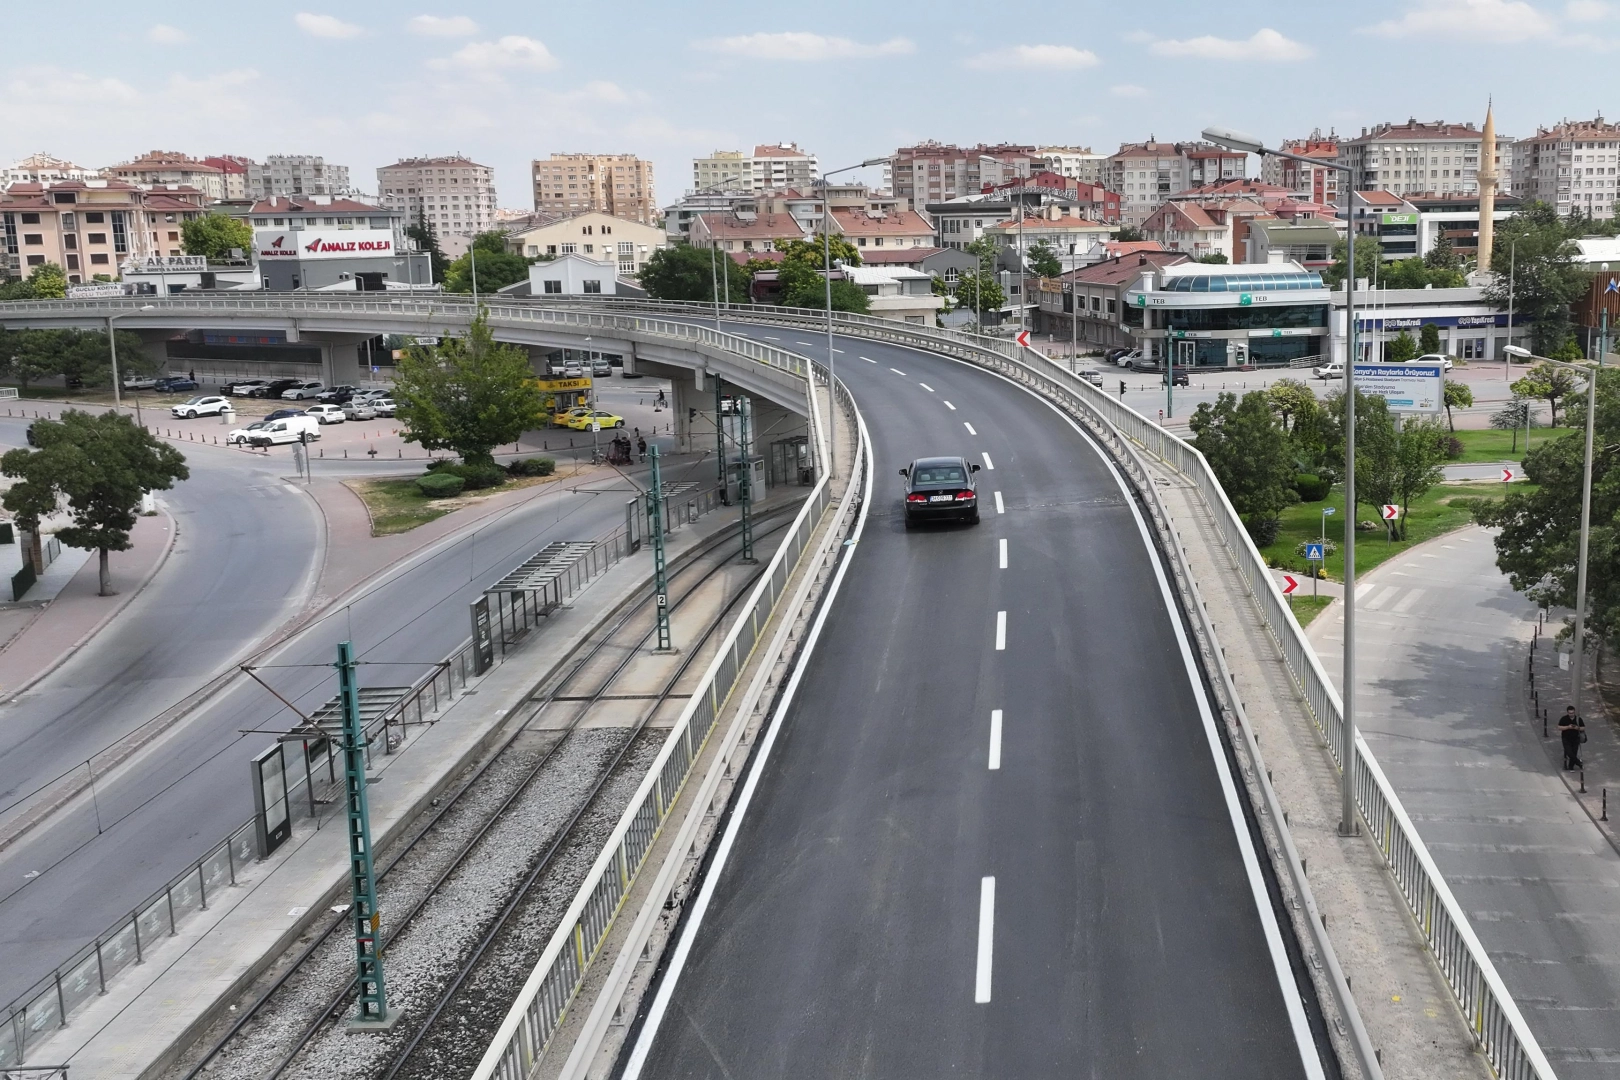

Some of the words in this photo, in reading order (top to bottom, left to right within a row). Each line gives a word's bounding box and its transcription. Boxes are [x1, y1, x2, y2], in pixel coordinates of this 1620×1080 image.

[320, 242, 356, 252] ANALİZ
[358, 240, 390, 250] KOLEJİ
[146, 257, 164, 266] AK
